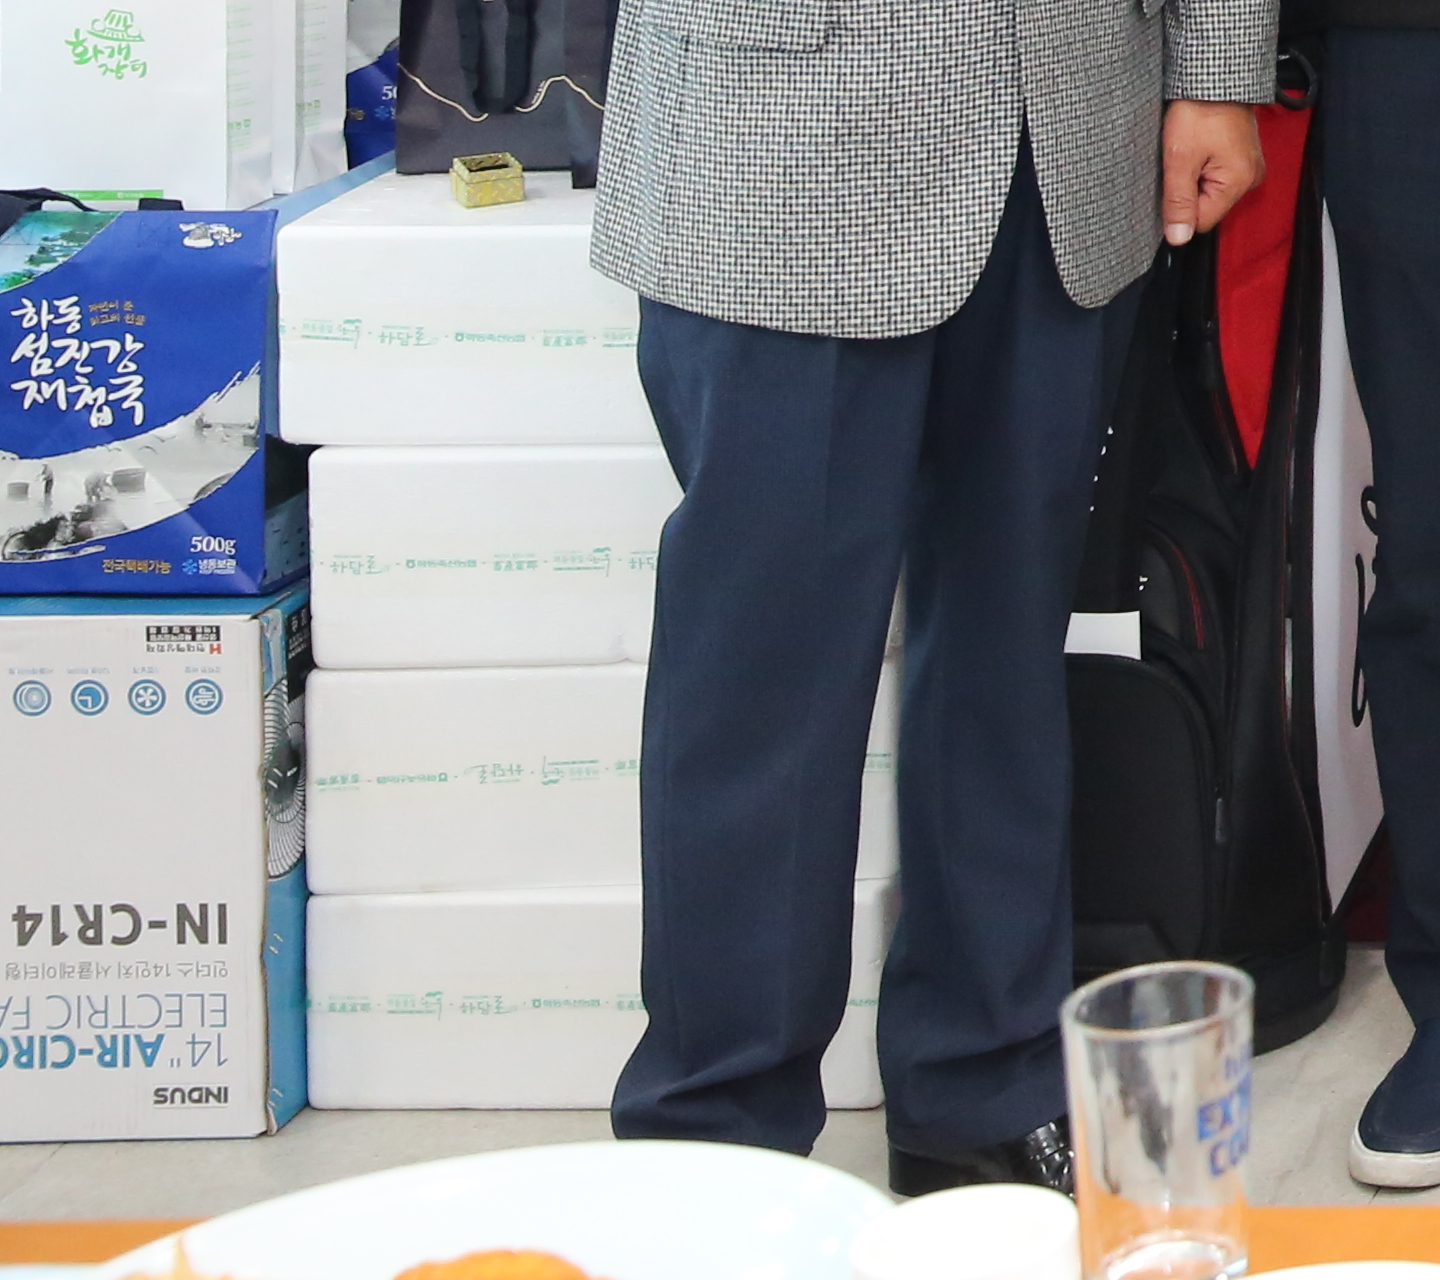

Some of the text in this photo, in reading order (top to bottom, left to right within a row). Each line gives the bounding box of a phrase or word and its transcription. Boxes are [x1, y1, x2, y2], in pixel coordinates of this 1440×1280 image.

[10, 295, 83, 335] 하동
[10, 331, 145, 378] 섬진강
[10, 374, 145, 429] 재첩국
[189, 536, 237, 555] 500g
[11, 903, 229, 947] IN-CR14
[4, 960, 229, 981] 인더스 14인치 서큘레이터형
[45, 992, 228, 1030] ELECTRIC
[152, 1086, 229, 1105] INDUS
